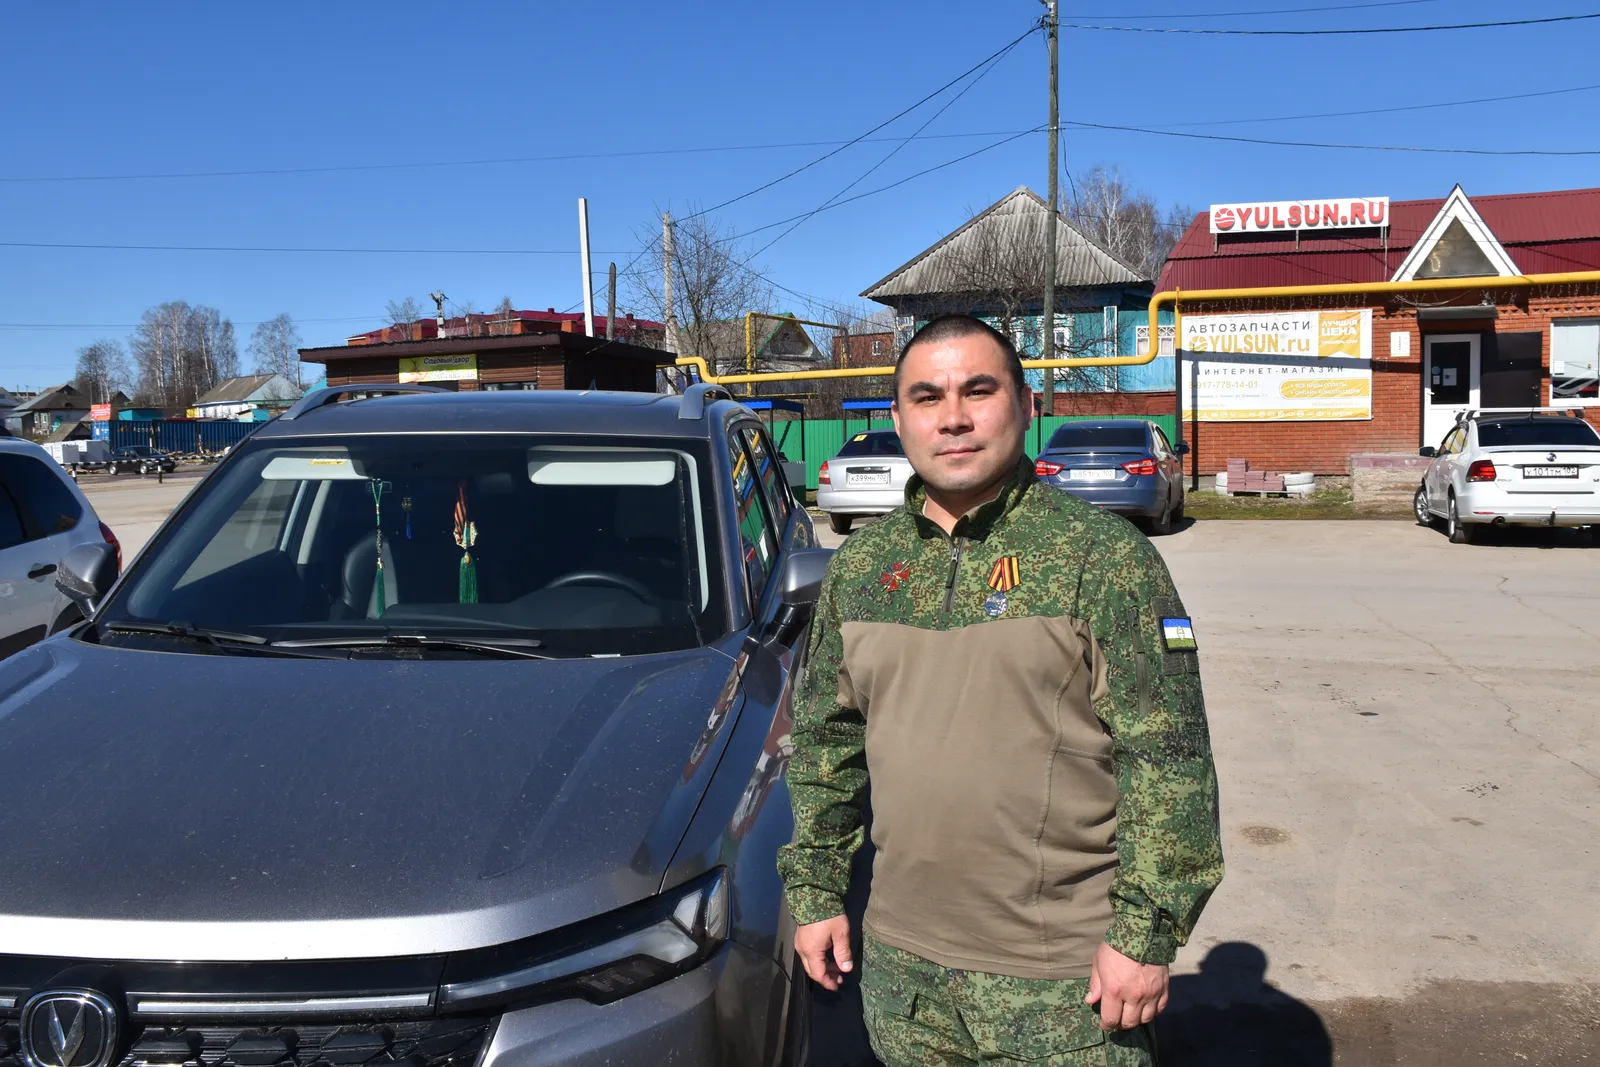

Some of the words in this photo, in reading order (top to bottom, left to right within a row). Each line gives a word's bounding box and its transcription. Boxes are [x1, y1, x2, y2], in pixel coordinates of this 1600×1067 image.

[1236, 201, 1385, 229] YULSUN.RU
[1188, 320, 1313, 334] АВТОЗАПЧАСТИ
[1321, 327, 1357, 337] ЦЕНА
[1204, 366, 1343, 375] ИНТЕРНЕТ-МАГАЗИН
